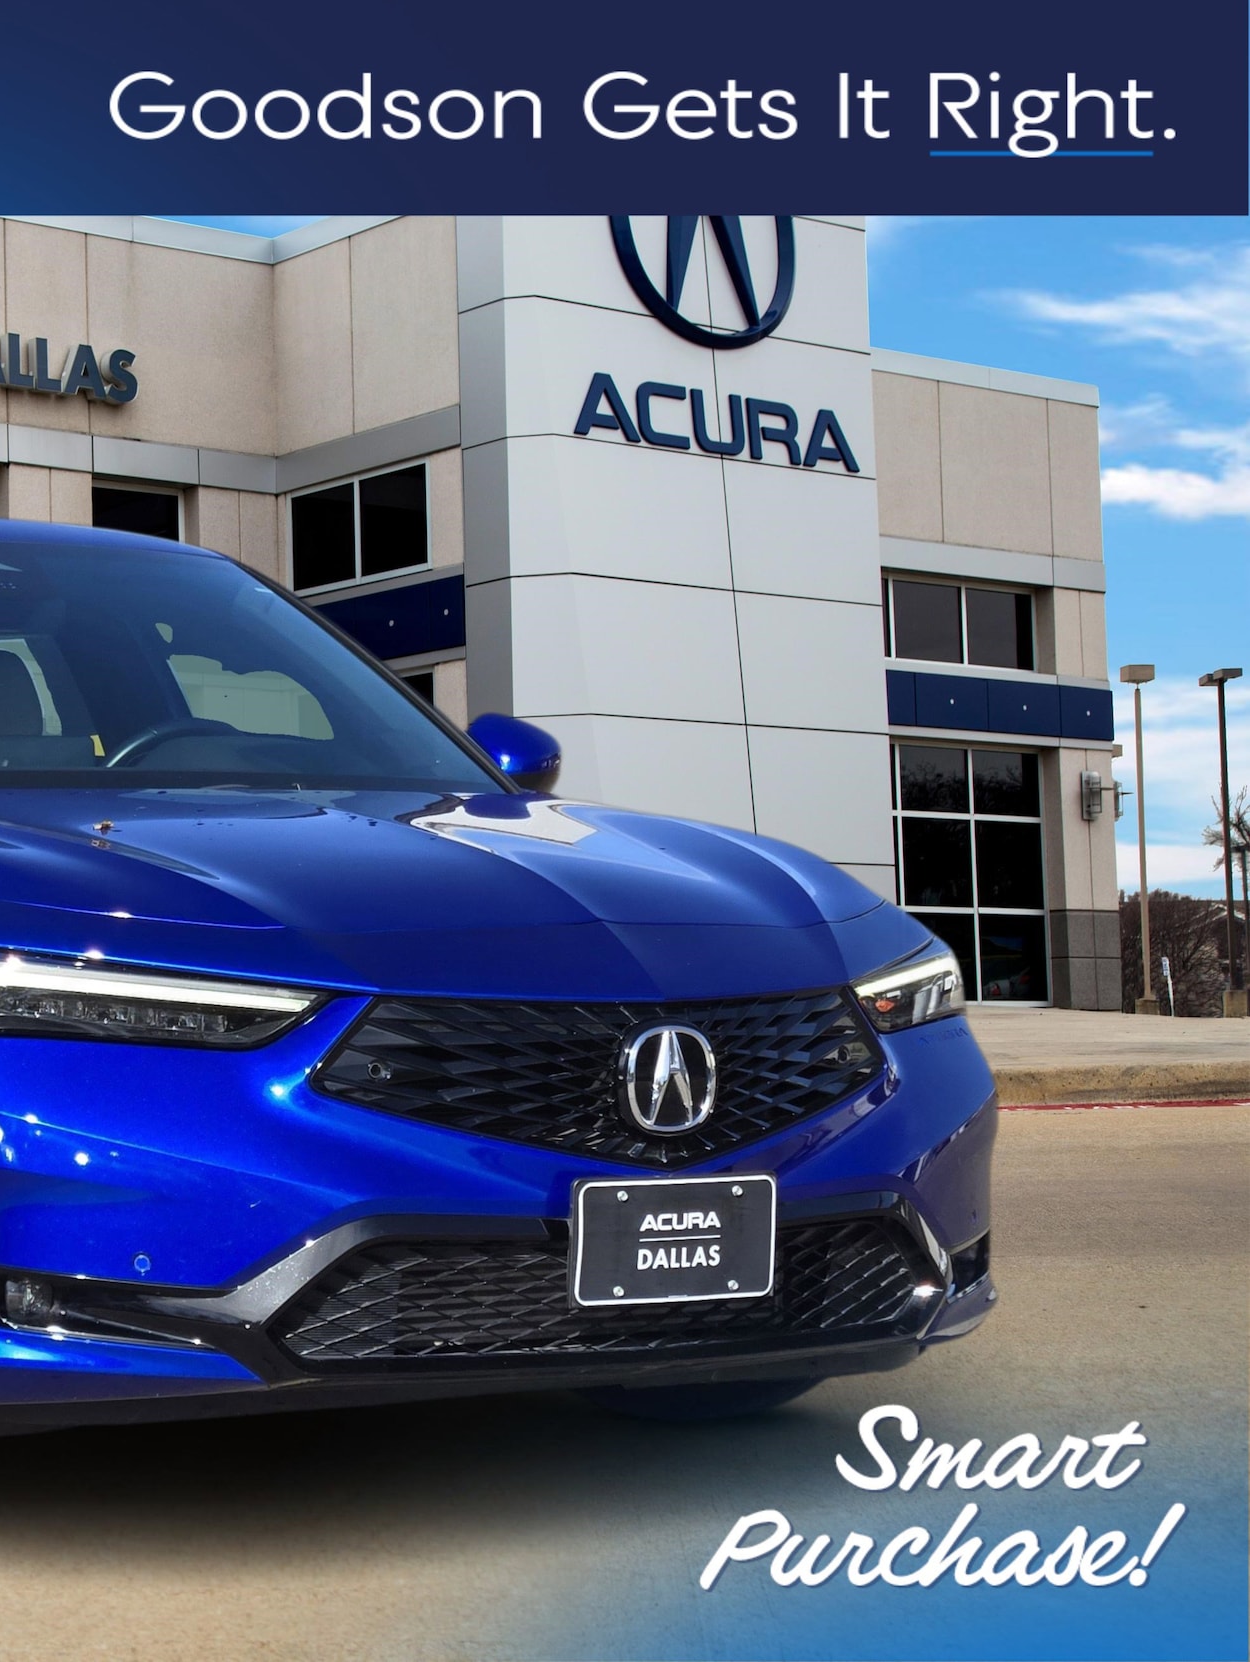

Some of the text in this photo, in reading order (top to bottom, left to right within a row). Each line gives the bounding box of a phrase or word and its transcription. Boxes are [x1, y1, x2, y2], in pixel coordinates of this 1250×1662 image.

[573, 371, 860, 474] ACURA
[639, 1211, 721, 1232] ACURA
[636, 1244, 721, 1271] DALLAS
